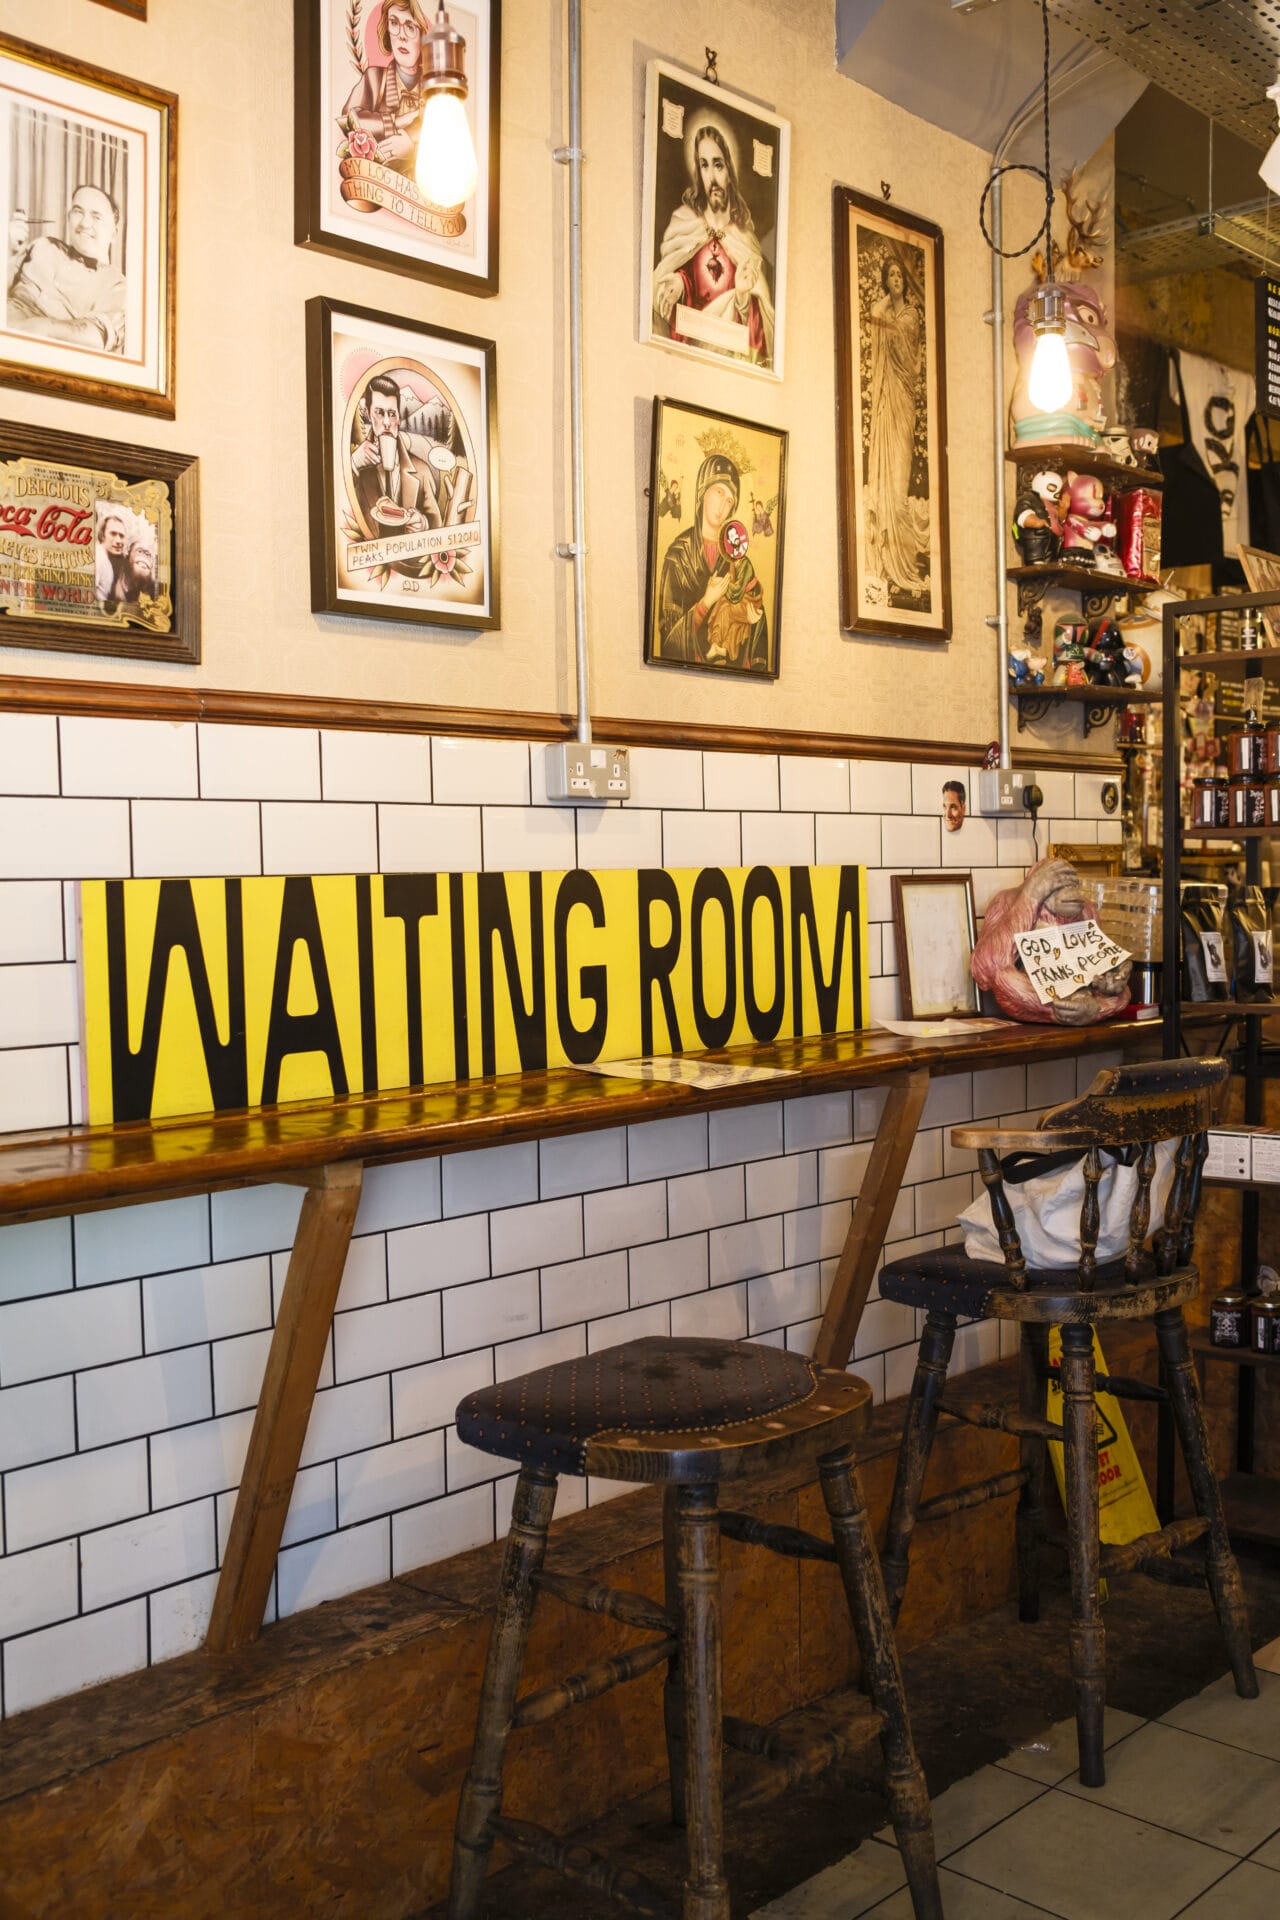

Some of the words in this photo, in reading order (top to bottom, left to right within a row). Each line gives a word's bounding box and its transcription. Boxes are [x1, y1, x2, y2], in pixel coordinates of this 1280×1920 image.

[344, 160, 362, 176] MY
[368, 160, 392, 185] LOG
[395, 173, 420, 201] HAS
[345, 180, 384, 204] THING
[390, 194, 405, 214] TO
[409, 205, 438, 233] TELL
[440, 216, 462, 235] YOU
[15, 477, 91, 508] DELICIOUS
[36, 504, 93, 545] Cola
[352, 541, 379, 555] TWIN
[386, 536, 442, 556] POPULATION
[352, 552, 385, 567] PEAKS
[41, 584, 95, 605] WORLD
[1020, 938, 1052, 957] GOD
[1062, 930, 1103, 949] LOVES
[1031, 964, 1075, 986] TRANS
[105, 869, 608, 1123] WAITING
[637, 865, 862, 1057] ROOM
[1098, 1450, 1110, 1469] ET
[1098, 1464, 1121, 1487] OOR
